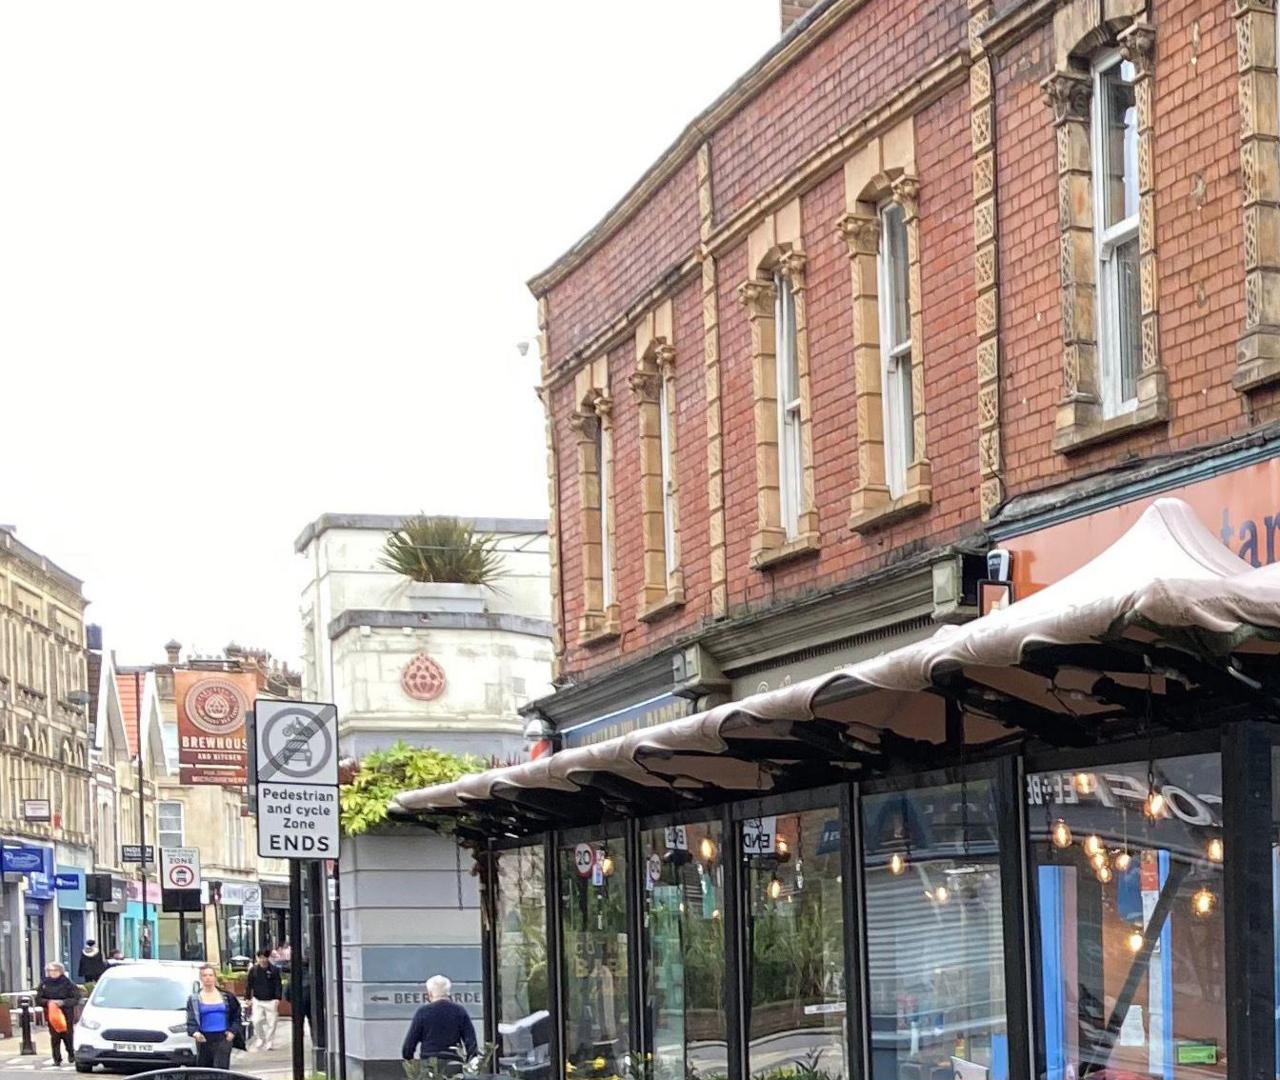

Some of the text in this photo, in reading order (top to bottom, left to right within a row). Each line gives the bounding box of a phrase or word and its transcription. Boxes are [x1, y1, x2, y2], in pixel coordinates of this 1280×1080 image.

[182, 736, 248, 749] BREWHOUS
[263, 788, 334, 801] Pedestrian
[267, 804, 331, 817] and cycle
[283, 818, 315, 829] Zone
[270, 834, 330, 852] ENDS
[394, 992, 431, 1004] BEER
